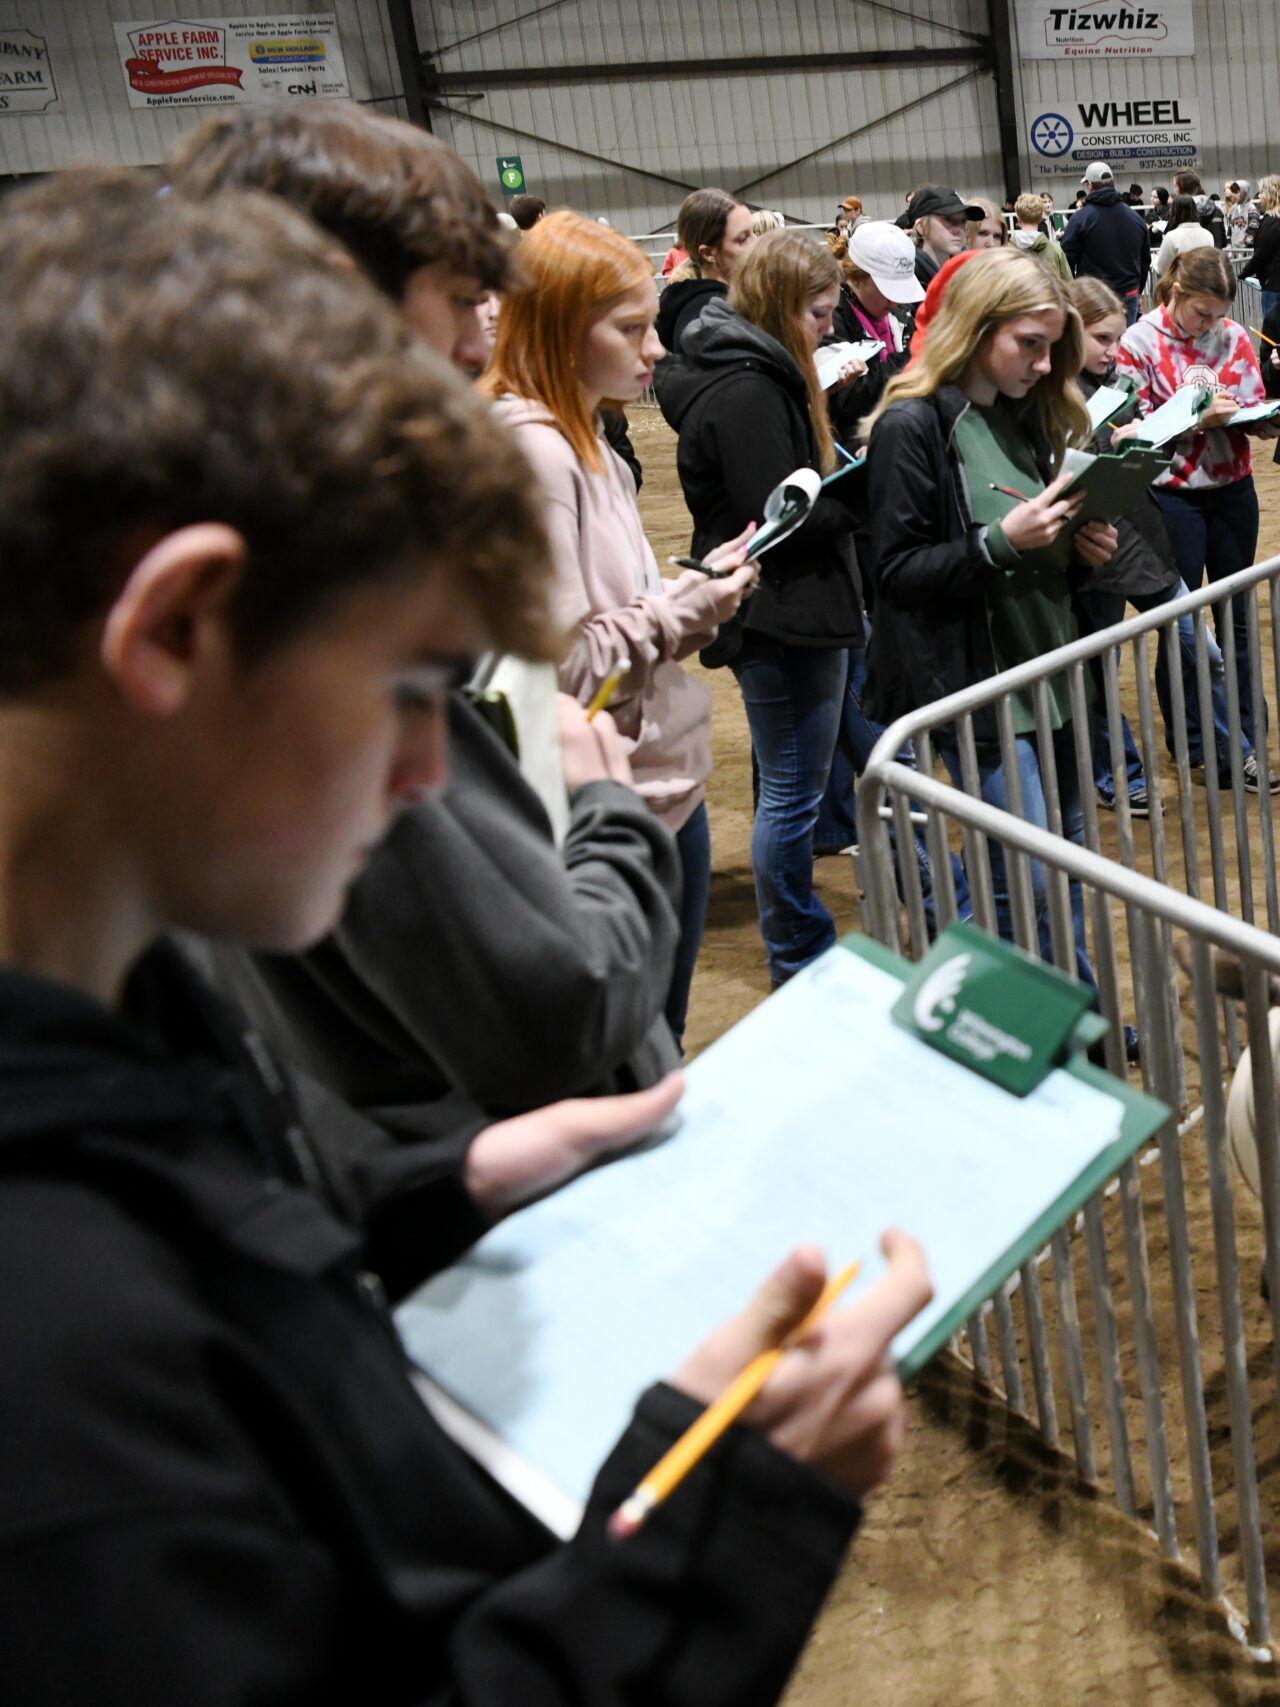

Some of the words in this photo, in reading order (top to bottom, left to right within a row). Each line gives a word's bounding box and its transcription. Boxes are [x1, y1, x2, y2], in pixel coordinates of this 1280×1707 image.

[1050, 8, 1159, 31] Tizwhiz
[139, 32, 179, 46] APPLE
[183, 31, 219, 45] FARM
[0, 42, 44, 60] PANY
[140, 47, 193, 61] SERVICE
[197, 47, 223, 59] INC.
[1064, 47, 1100, 56] Equine
[1105, 46, 1153, 54] Nutrition
[0, 70, 43, 85] ARM
[147, 95, 235, 105] AppleFarmService.com
[1078, 100, 1191, 128] WHEEL
[1081, 134, 1171, 147] CONSTRUCTORS,
[1173, 132, 1193, 142] INC.
[1076, 150, 1104, 160] DESIGN
[1109, 149, 1131, 158] BUILD
[1136, 146, 1193, 158] CONSTRUCTION
[508, 172, 515, 183] F
